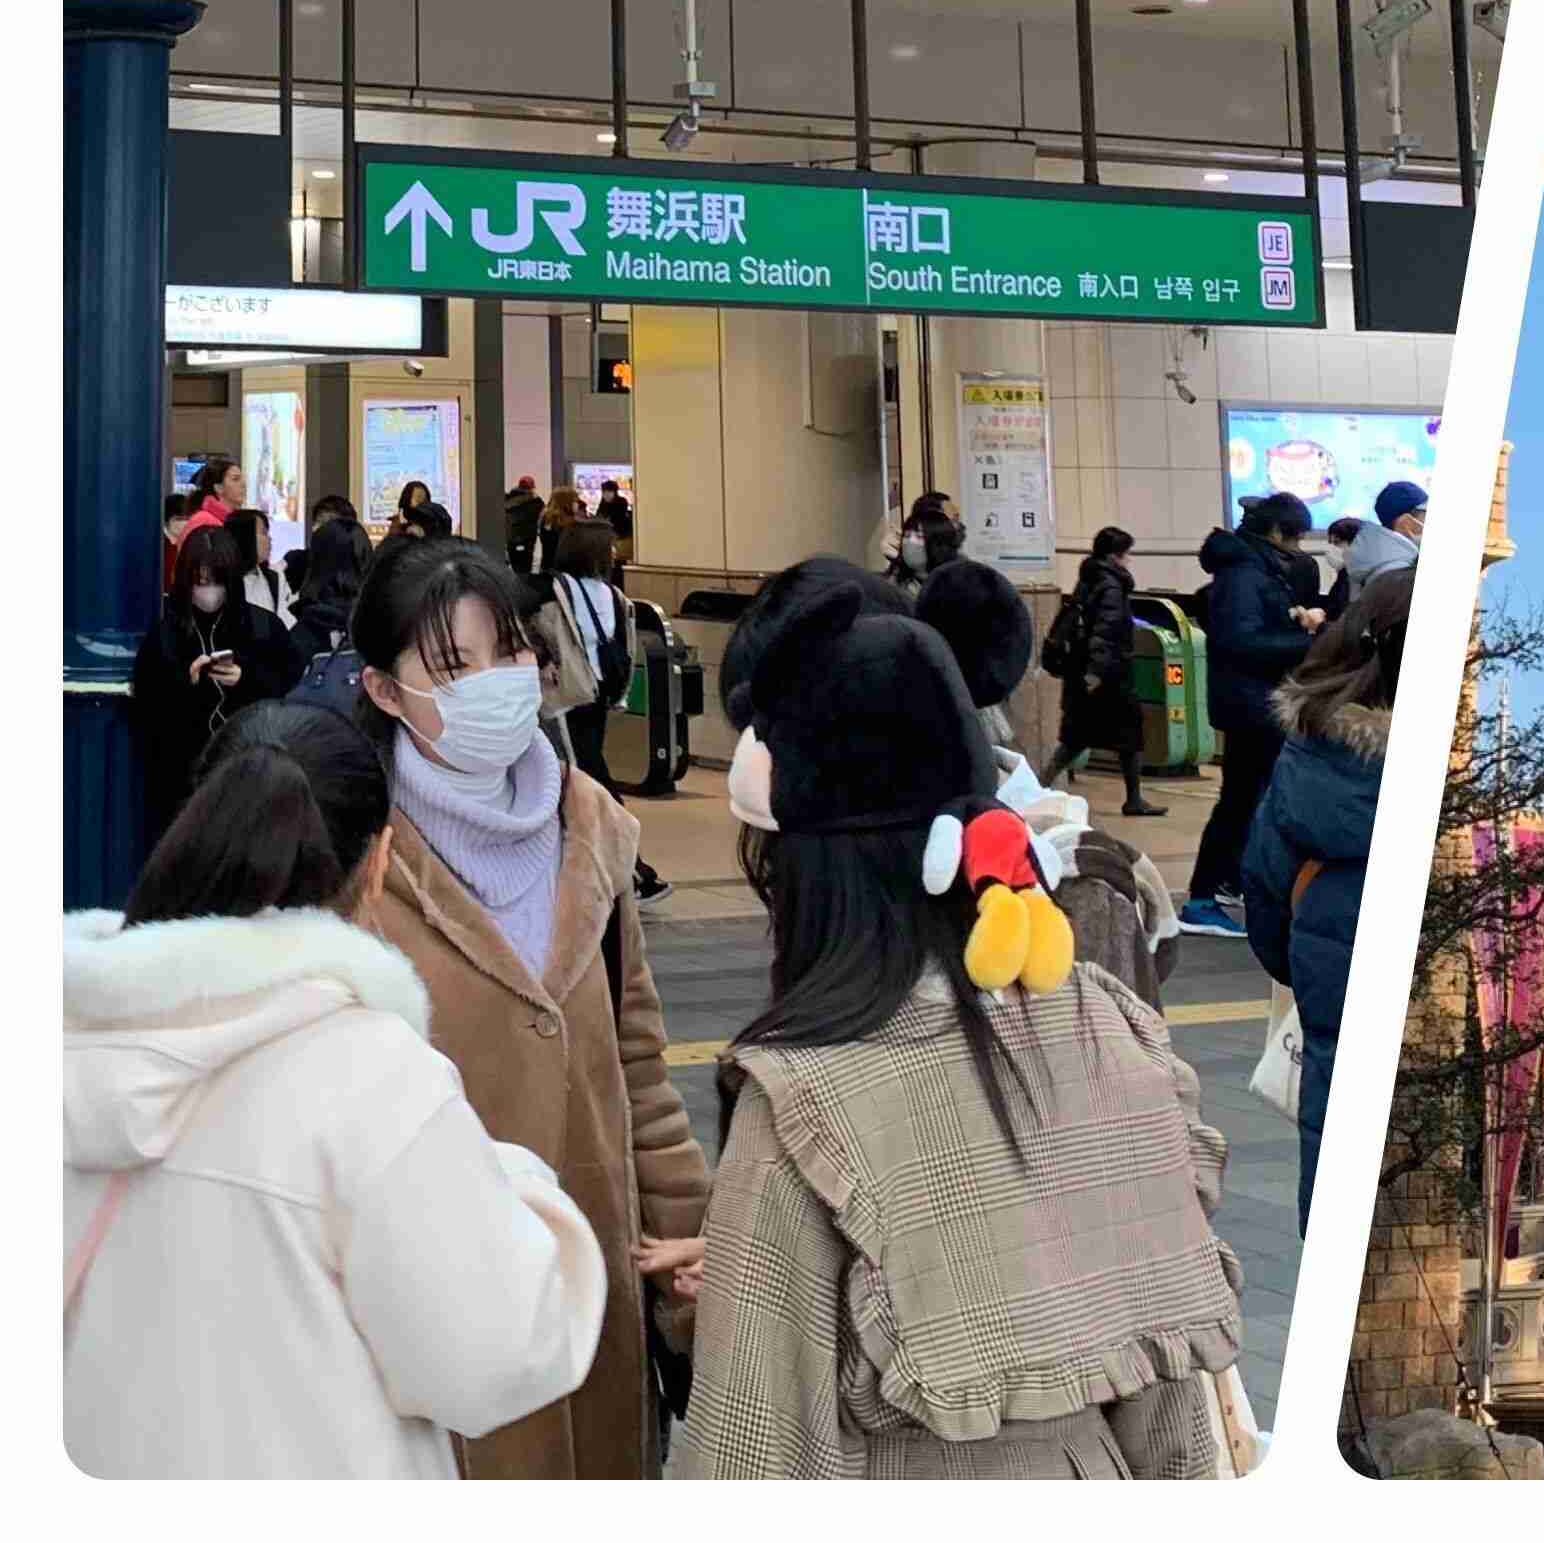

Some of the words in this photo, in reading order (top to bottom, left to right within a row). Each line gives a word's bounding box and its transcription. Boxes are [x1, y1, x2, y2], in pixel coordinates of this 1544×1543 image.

[471, 180, 587, 256] JR
[606, 186, 746, 245] 舞浜駅
[867, 201, 950, 255] 南口
[1265, 235, 1284, 252] JE
[487, 258, 572, 282] JR東日本
[606, 252, 730, 284] Maihama
[740, 256, 831, 287] Station
[869, 263, 942, 294] South
[951, 266, 1062, 298] Entrance
[1079, 272, 1139, 300] 南入口
[1155, 277, 1193, 302] 남쪽
[1202, 279, 1241, 303] 입구
[1268, 279, 1288, 298] JM
